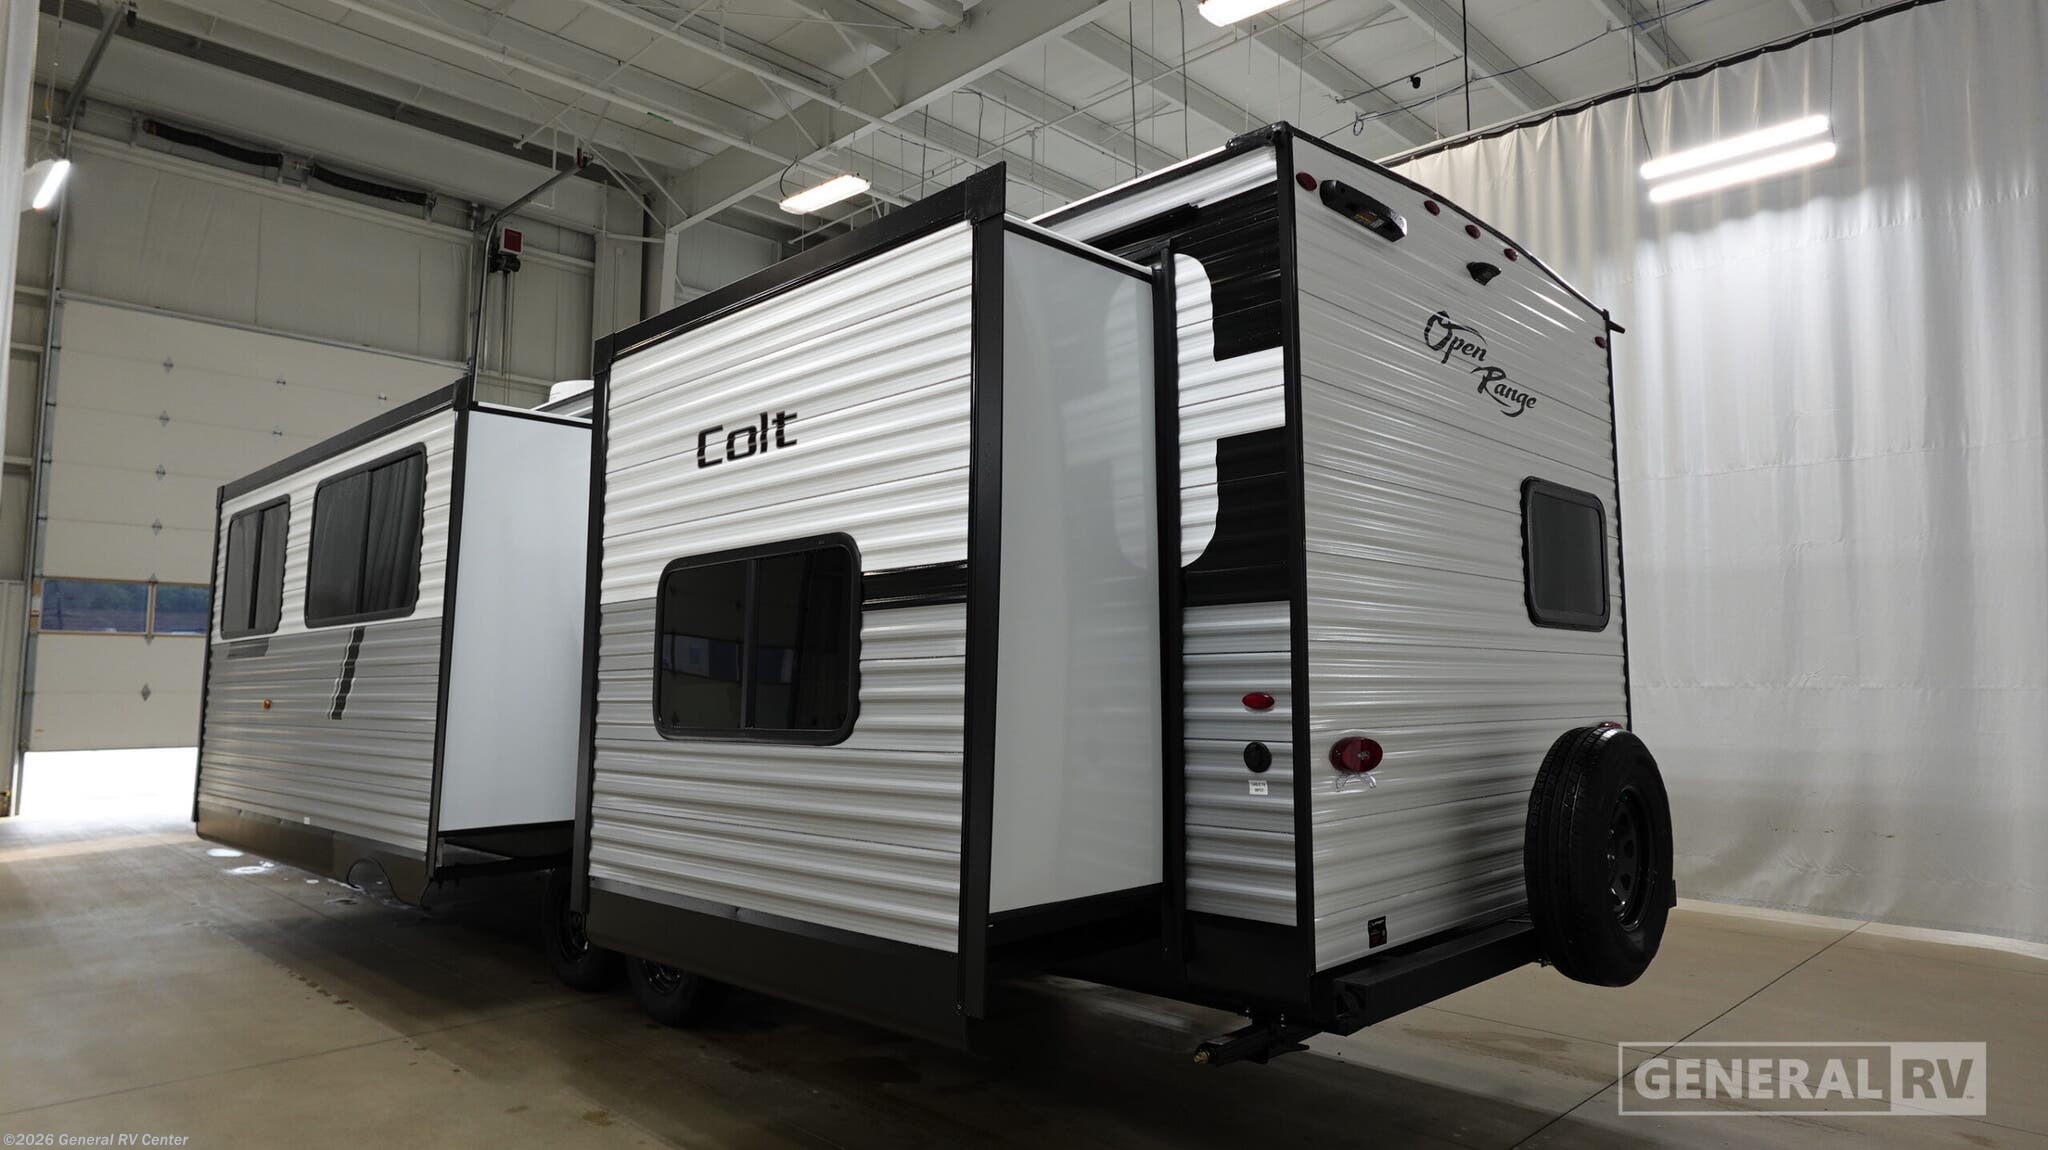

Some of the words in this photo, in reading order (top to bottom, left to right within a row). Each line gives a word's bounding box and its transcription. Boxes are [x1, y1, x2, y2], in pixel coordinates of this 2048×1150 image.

[1424, 311, 1488, 364] Open
[1470, 366, 1537, 417] Range
[697, 410, 798, 469] Colt
